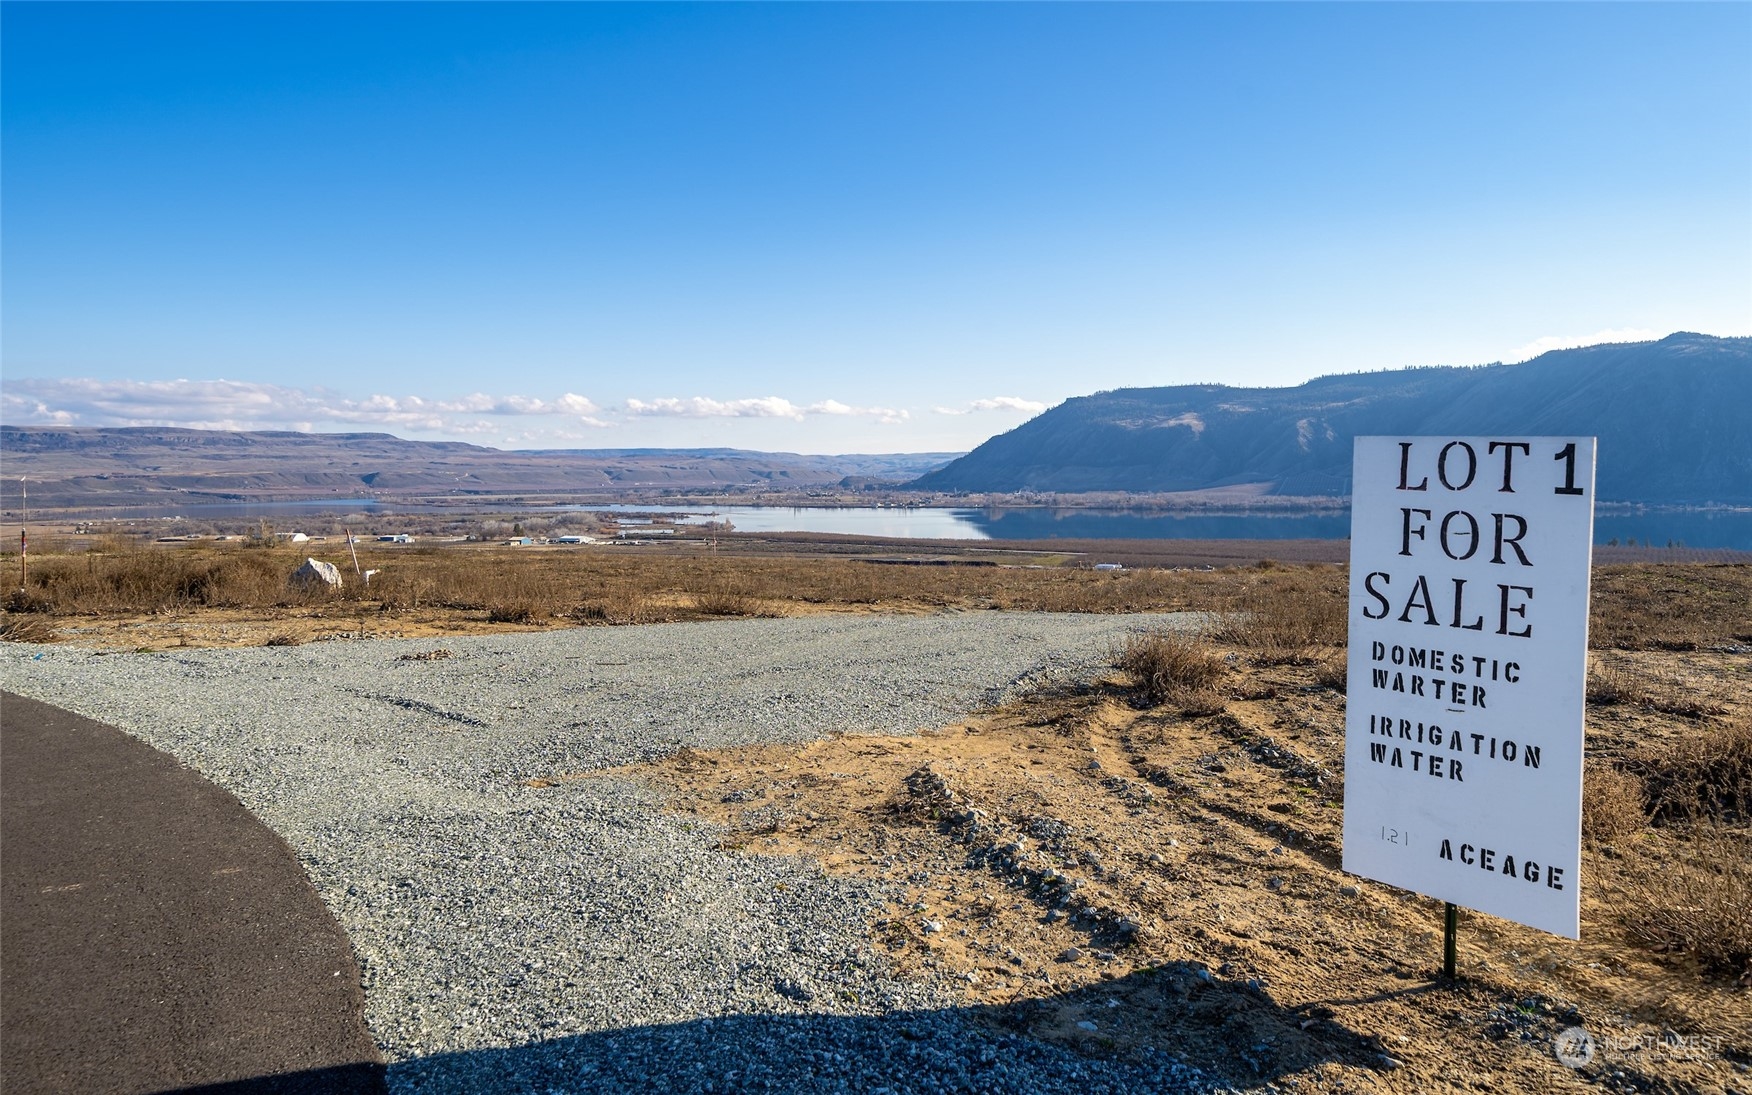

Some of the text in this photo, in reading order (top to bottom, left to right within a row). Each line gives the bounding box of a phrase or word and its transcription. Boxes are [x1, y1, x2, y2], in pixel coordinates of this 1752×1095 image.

[1396, 441, 1584, 495] LOT 1
[1398, 508, 1534, 566] FOR
[1363, 572, 1534, 638] SALE
[1372, 641, 1521, 683] DOMESTIC
[1372, 668, 1486, 709] WARTER
[1370, 715, 1541, 768] IRRIGATION
[1370, 742, 1464, 782] WATER
[1439, 839, 1564, 890] ACEAGE
